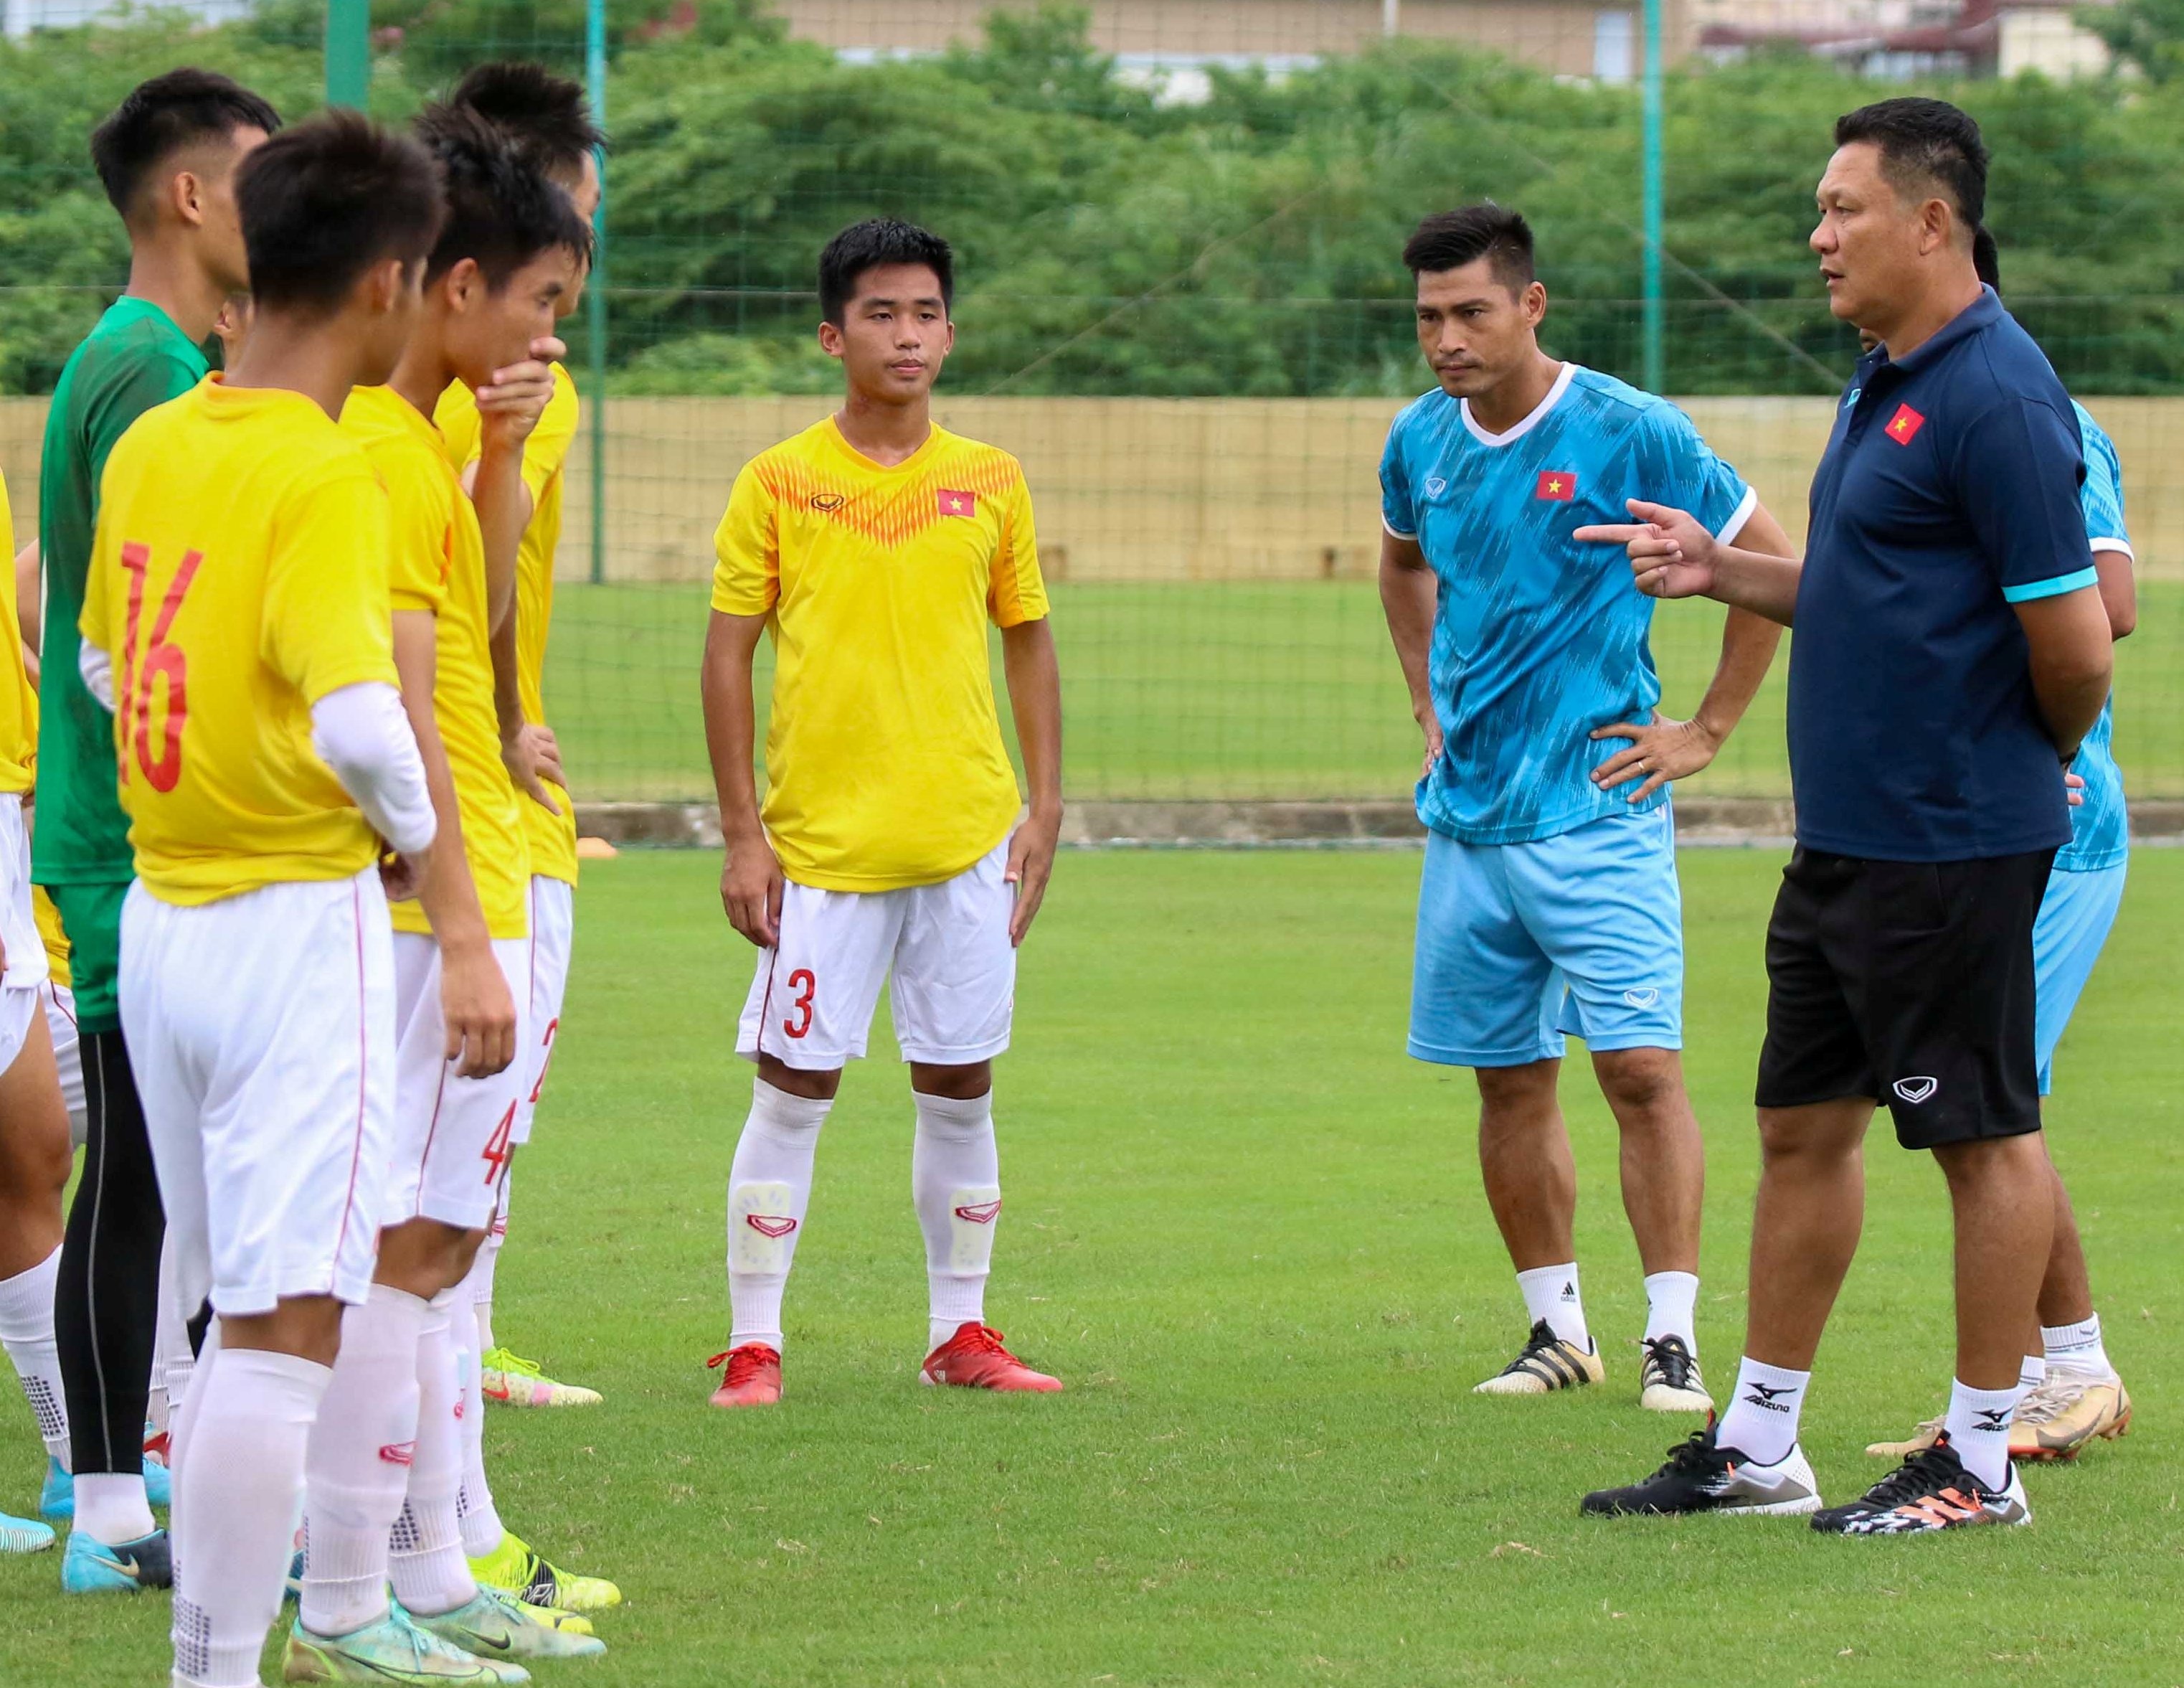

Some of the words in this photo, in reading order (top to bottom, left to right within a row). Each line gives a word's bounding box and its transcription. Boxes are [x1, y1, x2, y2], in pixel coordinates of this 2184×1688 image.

[121, 541, 204, 793] 16
[784, 968, 816, 1039] 3
[481, 1098, 517, 1185] 4
